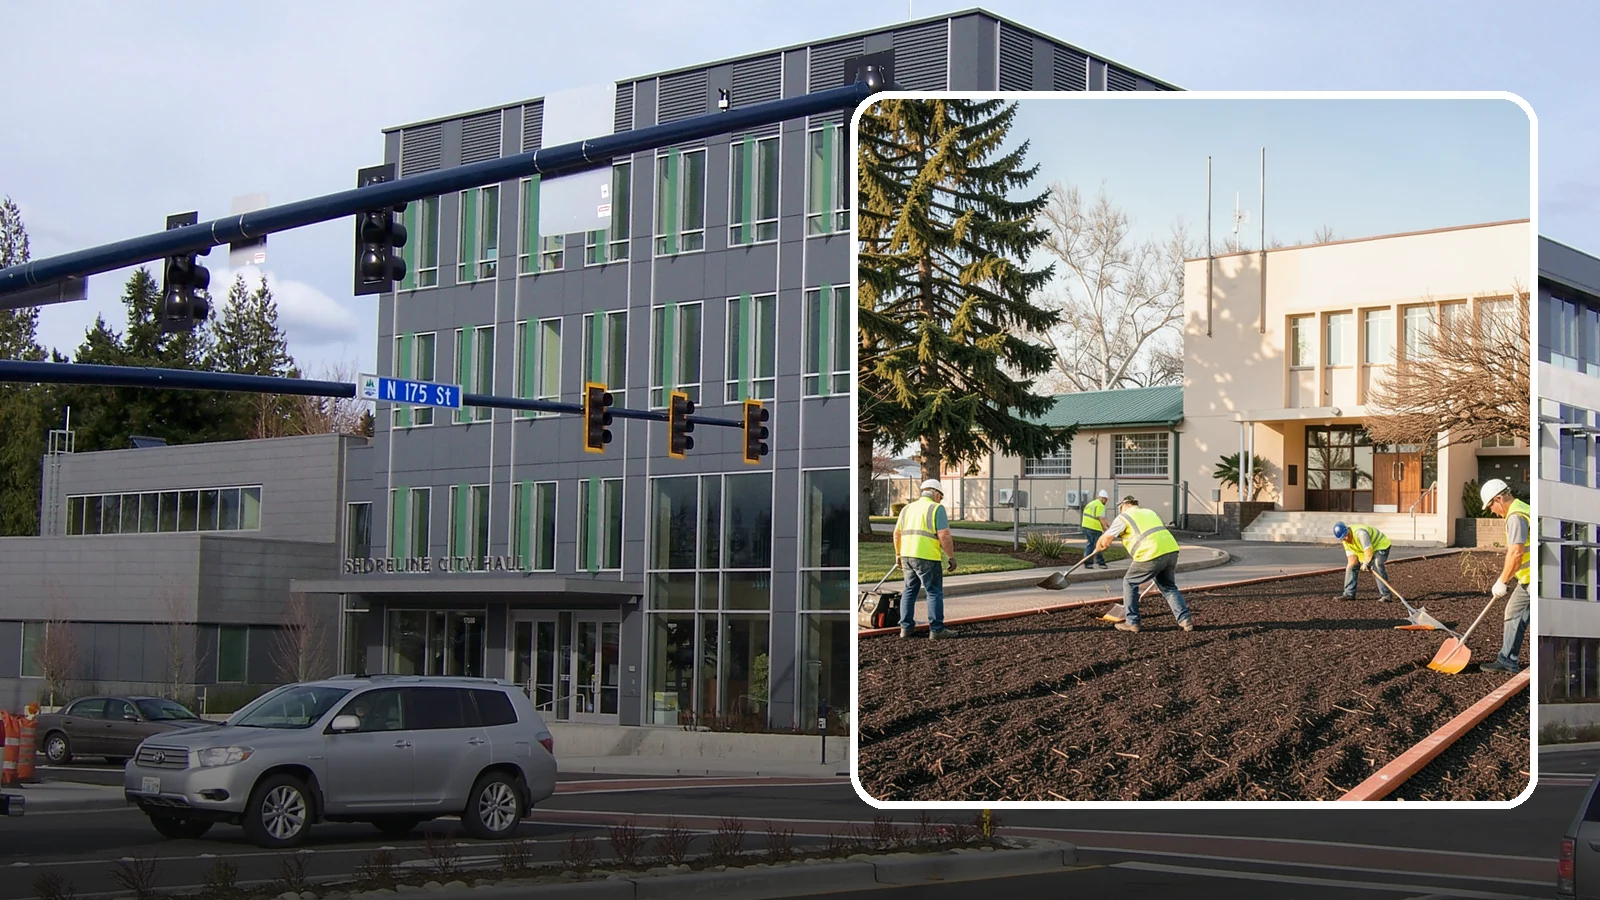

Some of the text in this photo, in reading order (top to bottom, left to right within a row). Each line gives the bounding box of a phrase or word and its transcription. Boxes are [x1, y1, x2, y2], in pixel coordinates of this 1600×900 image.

[387, 380, 451, 406] N 175 St
[344, 555, 526, 574] SHORELINE CITY HALL
